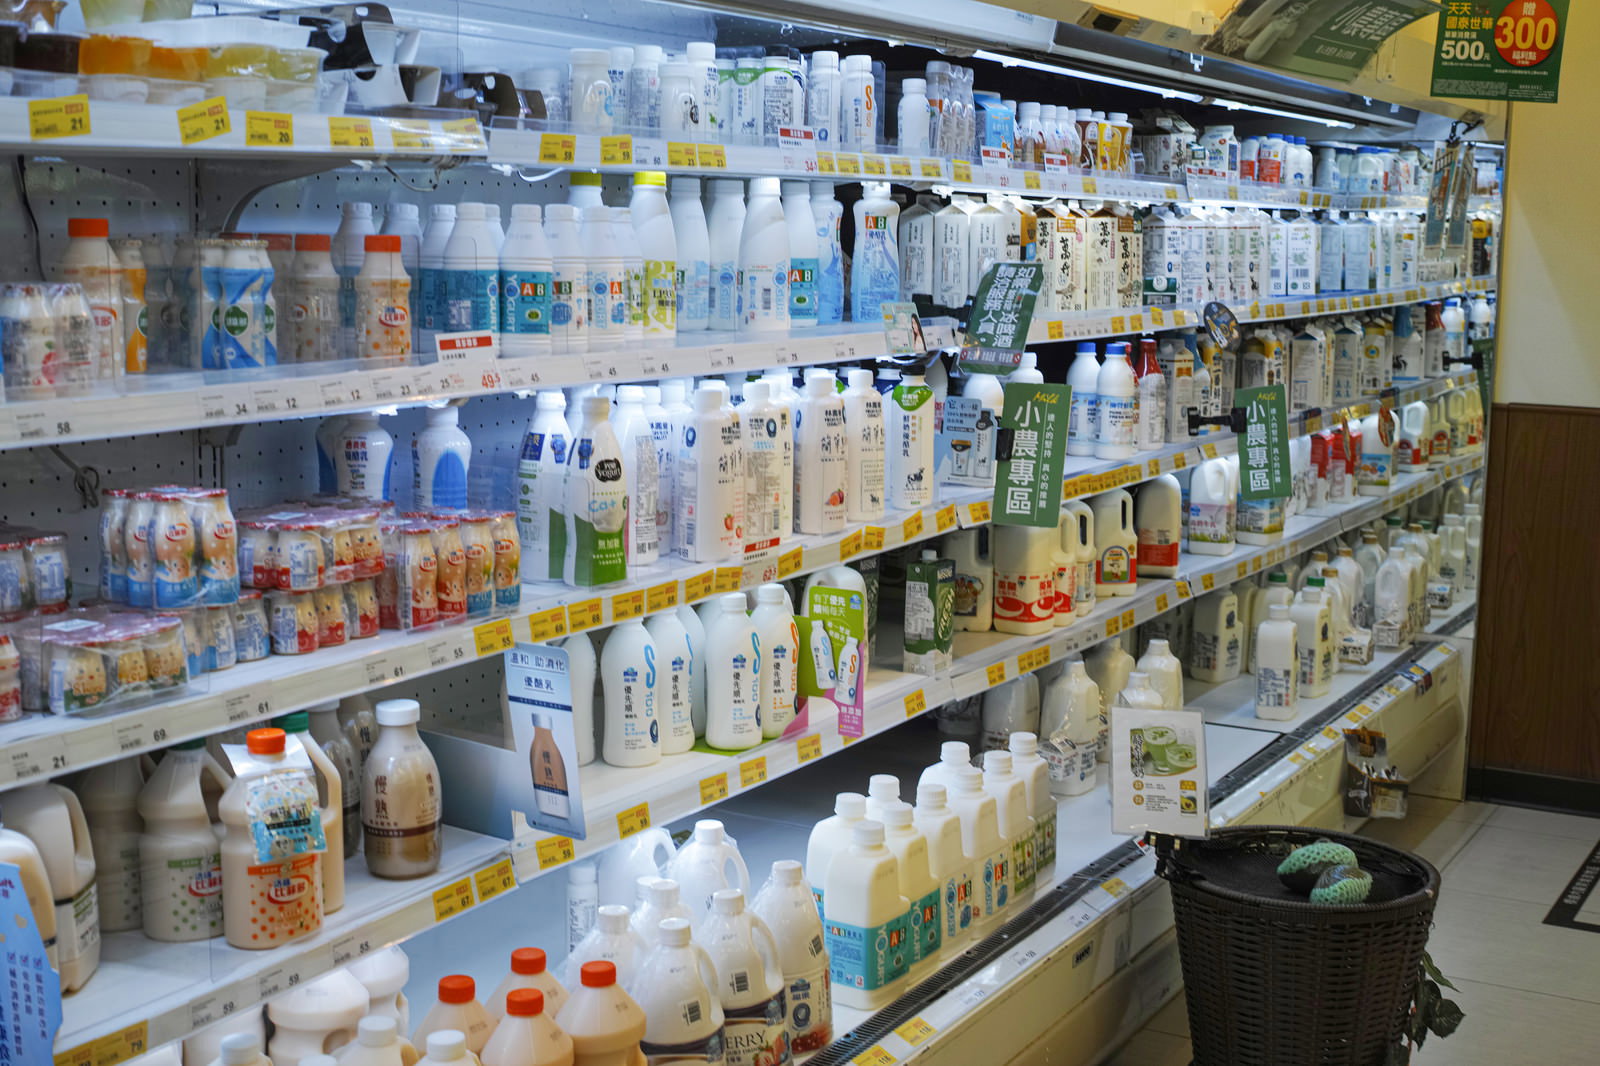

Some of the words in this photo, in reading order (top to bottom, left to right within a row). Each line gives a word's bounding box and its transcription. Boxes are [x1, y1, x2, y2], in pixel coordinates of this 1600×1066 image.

[1447, 2, 1472, 15] 天天
[1446, 16, 1493, 30] 國泰世華
[1494, 16, 1556, 50] 300
[71, 118, 84, 131] 21
[214, 118, 226, 130] 21
[279, 131, 290, 143] 20
[359, 136, 370, 147] 20
[865, 216, 887, 229] AB
[791, 269, 812, 281] AB
[522, 283, 545, 295] AB
[608, 367, 617, 377] 45
[661, 363, 670, 373] 45
[440, 378, 450, 389] 25
[530, 373, 540, 383] 45
[350, 389, 361, 400] 12
[400, 385, 411, 395] 23
[235, 403, 247, 415] 34
[285, 398, 297, 408] 12
[57, 421, 71, 434] 58
[1246, 400, 1270, 492] 小農專區
[1006, 400, 1040, 514] 小農專區
[502, 636, 511, 647] 55
[454, 648, 464, 659] 55
[510, 652, 529, 665] 溫和
[534, 655, 565, 671] 助消化
[394, 665, 403, 677] 61
[773, 662, 782, 687] 優先順
[524, 676, 553, 691] 優酪乳
[672, 675, 680, 700] 優先順
[733, 672, 741, 697] 優先順
[624, 686, 634, 712] 優先順
[258, 702, 270, 714] 61
[153, 730, 167, 742] 69
[52, 756, 67, 769] 21
[375, 775, 389, 820] 慢熟
[504, 877, 512, 890] 67
[461, 895, 471, 907] 67
[359, 943, 369, 954] 55
[288, 974, 299, 986] 59
[222, 1001, 234, 1013] 59
[131, 1041, 143, 1053] 79
